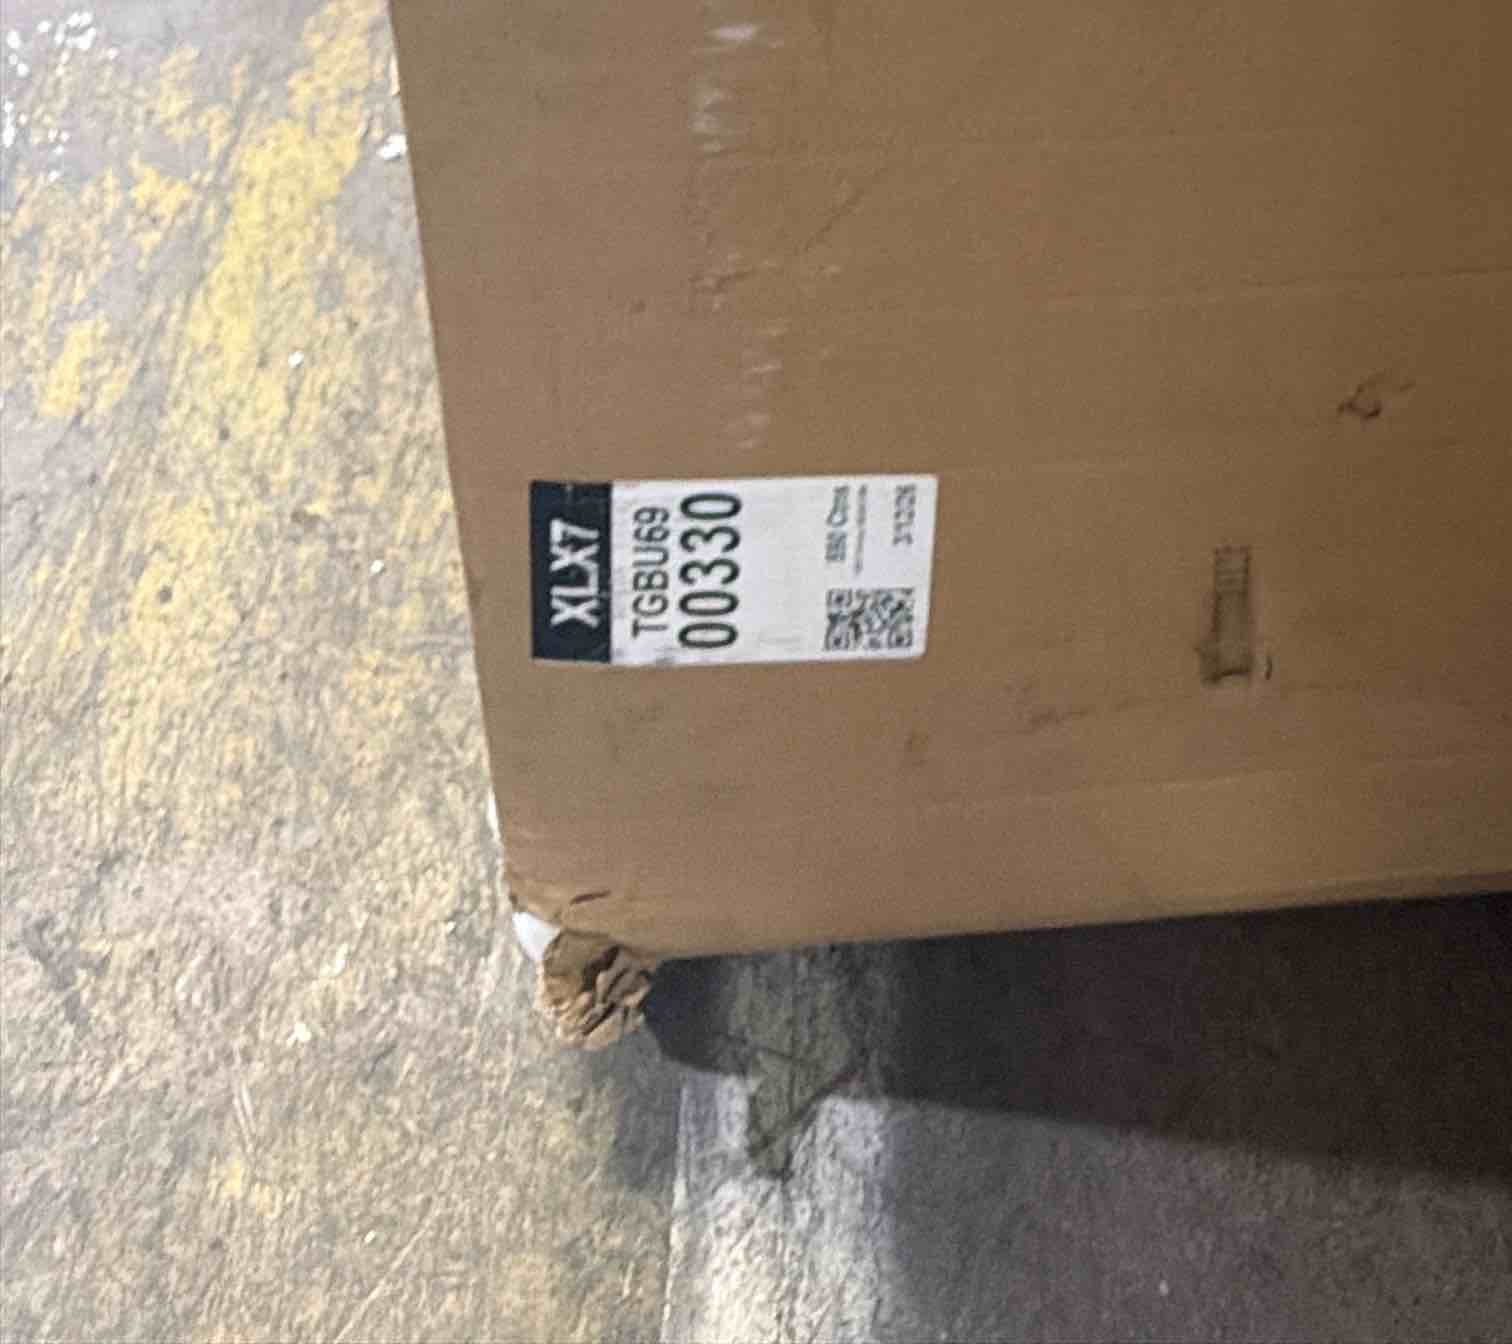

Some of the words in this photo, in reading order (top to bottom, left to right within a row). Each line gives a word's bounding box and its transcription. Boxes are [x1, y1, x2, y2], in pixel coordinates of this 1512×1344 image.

[549, 517, 600, 629] XLX7
[631, 505, 671, 640] TGBU69
[677, 492, 743, 650] 00330
